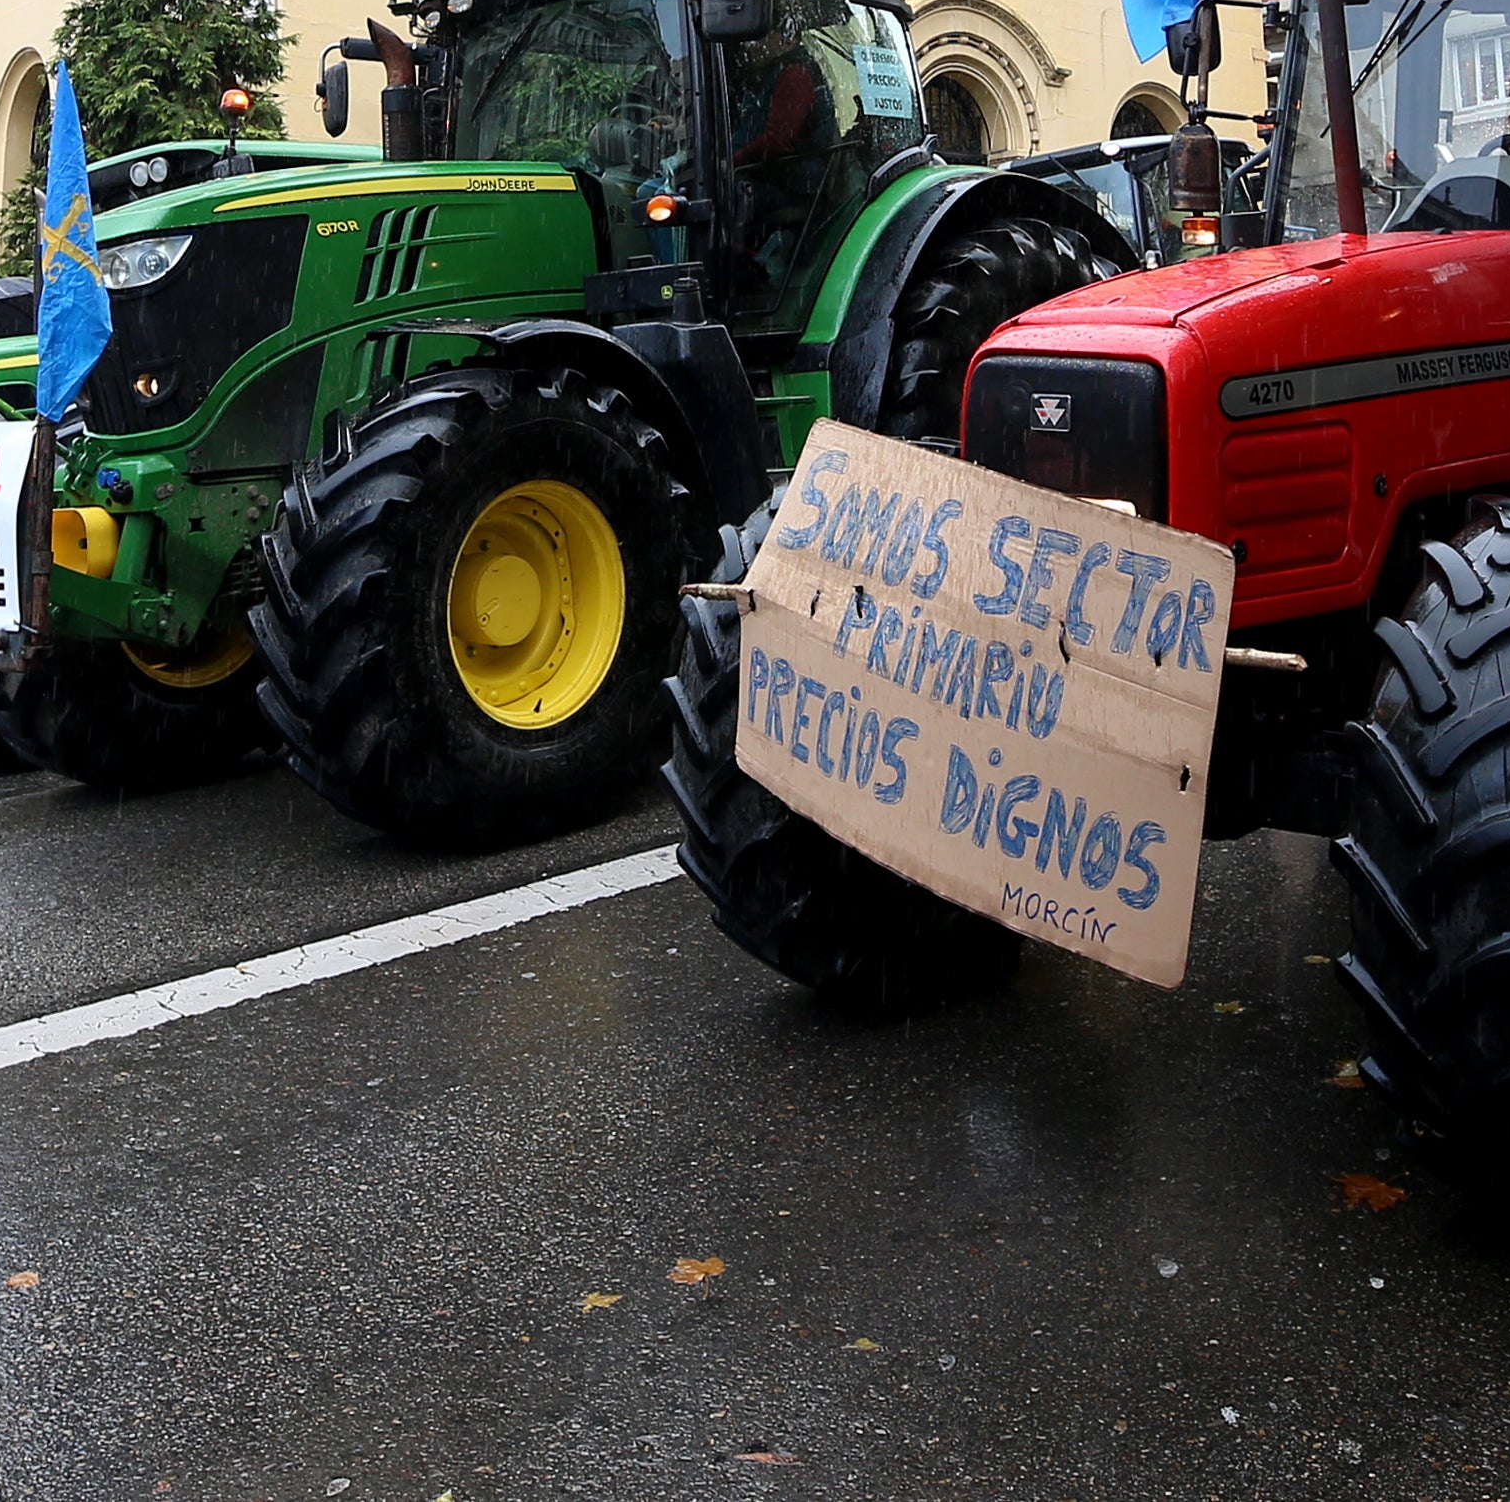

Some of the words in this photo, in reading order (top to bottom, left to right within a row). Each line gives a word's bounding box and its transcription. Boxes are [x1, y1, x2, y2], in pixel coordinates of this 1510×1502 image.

[868, 74, 901, 87] PRECIOS
[466, 178, 496, 191] JOHN
[498, 178, 536, 190] DEERE
[316, 220, 361, 237] 6170R
[1396, 356, 1455, 384] MASSEY
[1248, 379, 1294, 406] 4270
[777, 449, 962, 599] SOMOS
[973, 515, 1215, 673] SECTOR
